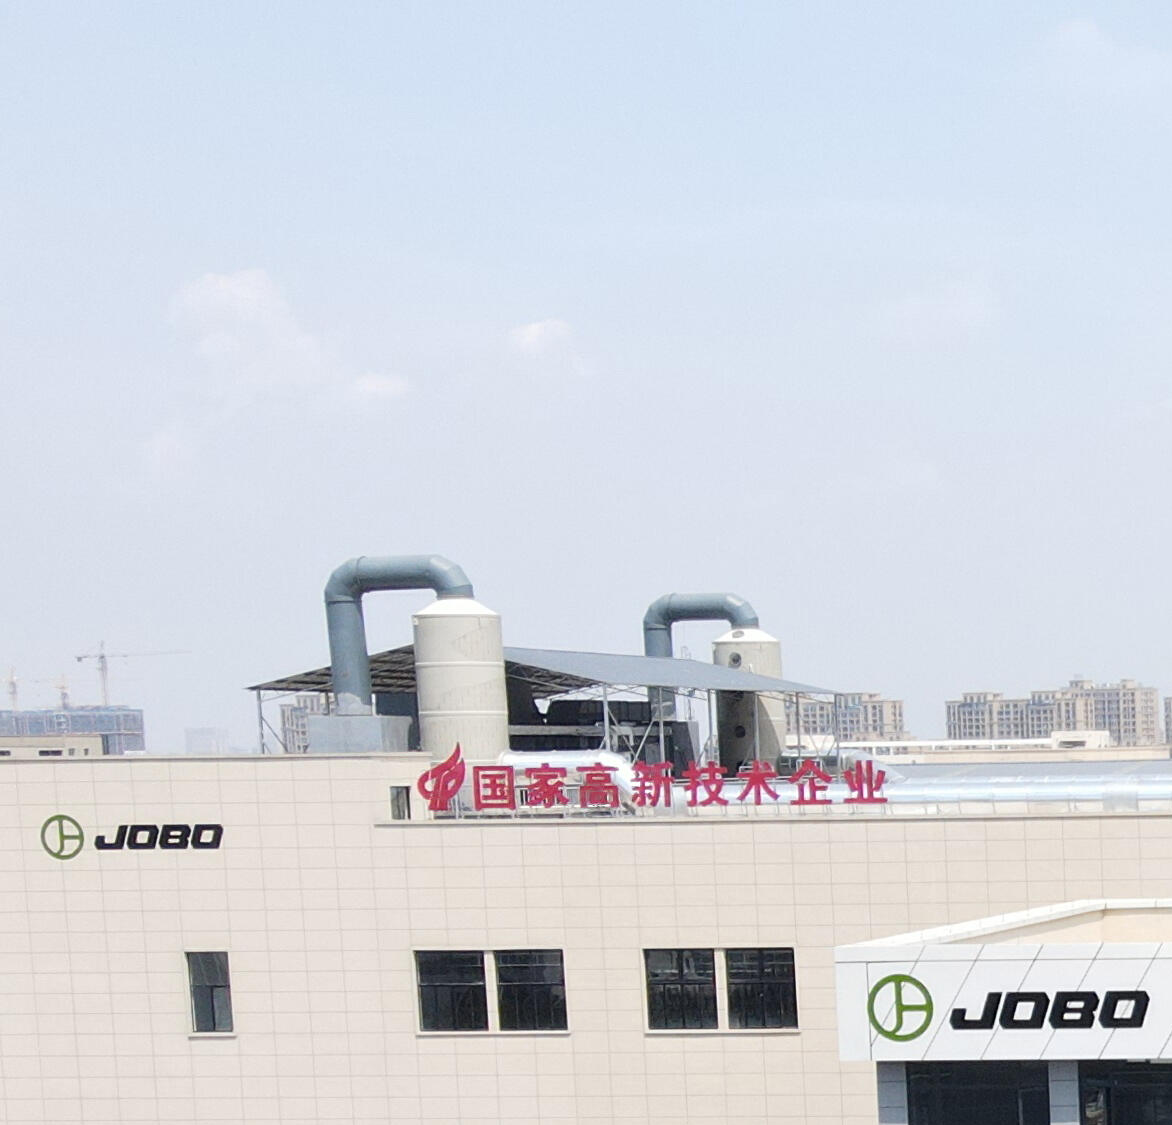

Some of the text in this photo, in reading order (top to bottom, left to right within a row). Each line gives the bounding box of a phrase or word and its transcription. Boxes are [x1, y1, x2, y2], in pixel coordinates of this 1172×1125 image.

[473, 758, 888, 812] 国家高新技术企业
[94, 823, 224, 851] JOBO
[949, 990, 1151, 1030] JOBO
